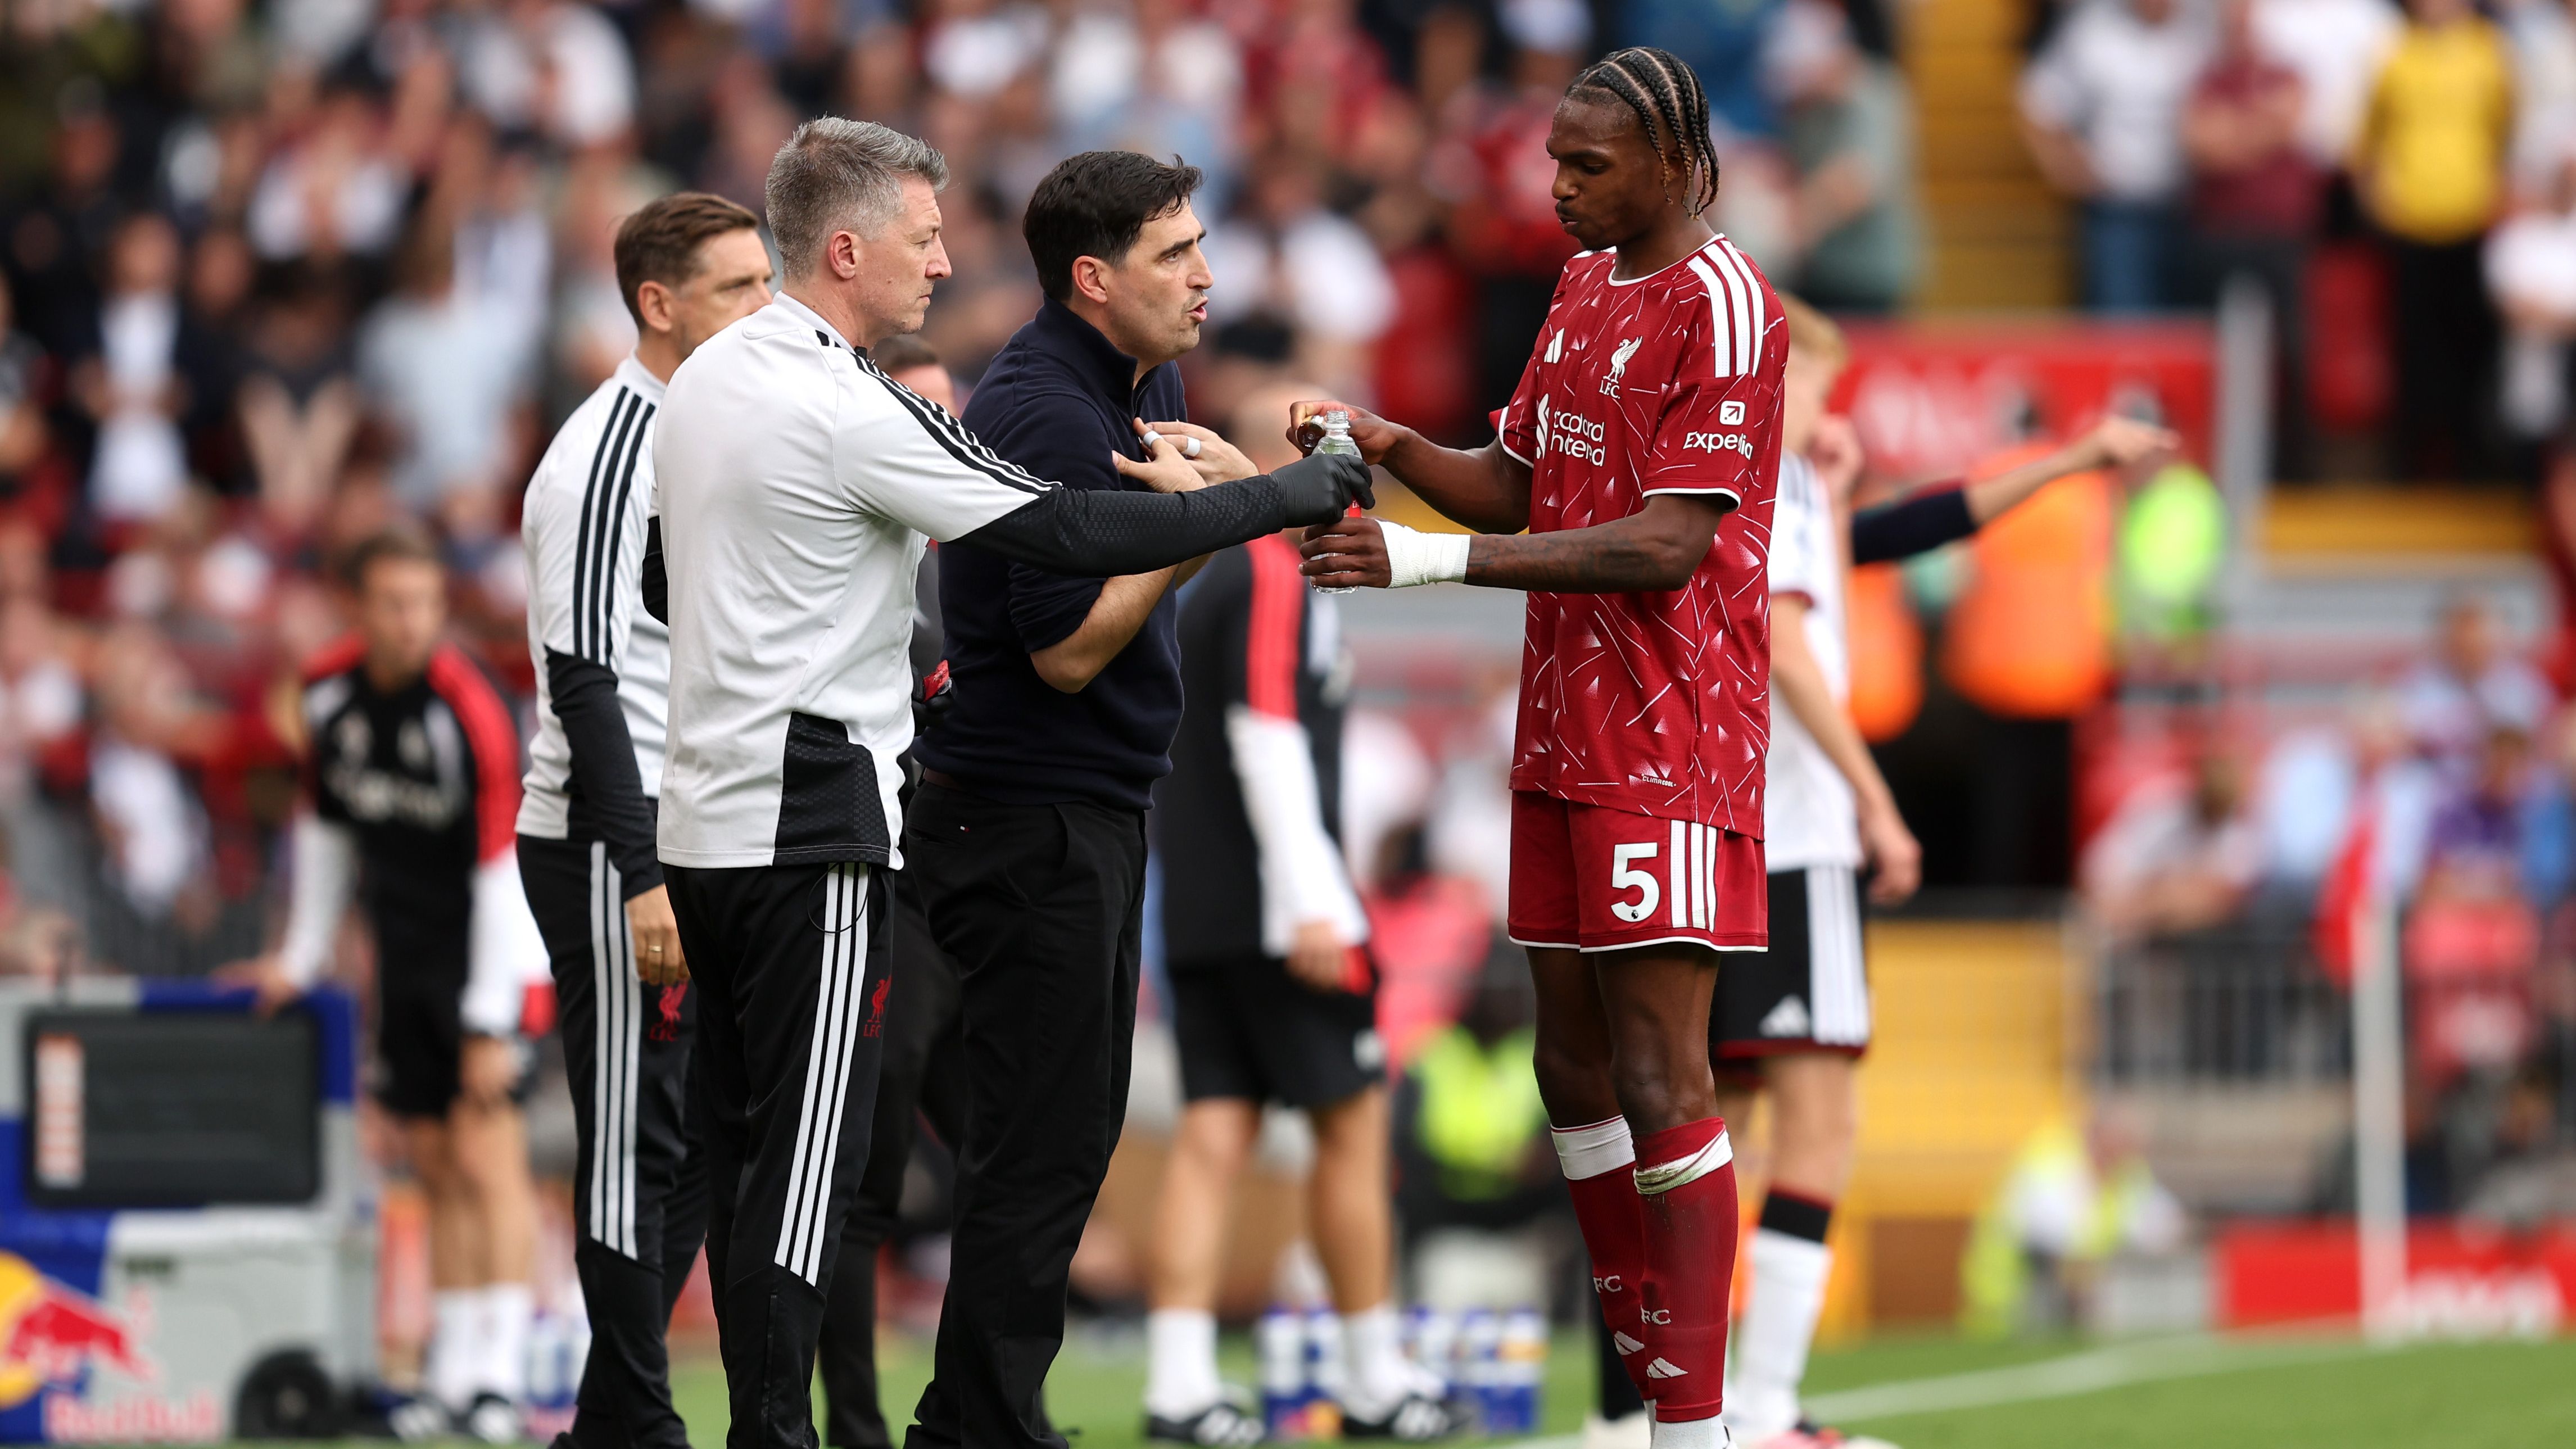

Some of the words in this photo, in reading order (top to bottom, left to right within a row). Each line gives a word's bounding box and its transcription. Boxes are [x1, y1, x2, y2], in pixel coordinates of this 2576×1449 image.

[1610, 842, 1660, 922] 5
[863, 1024, 882, 1038] LFC
[1593, 1275, 1622, 1293] FC
[1640, 1304, 1671, 1325] FC
